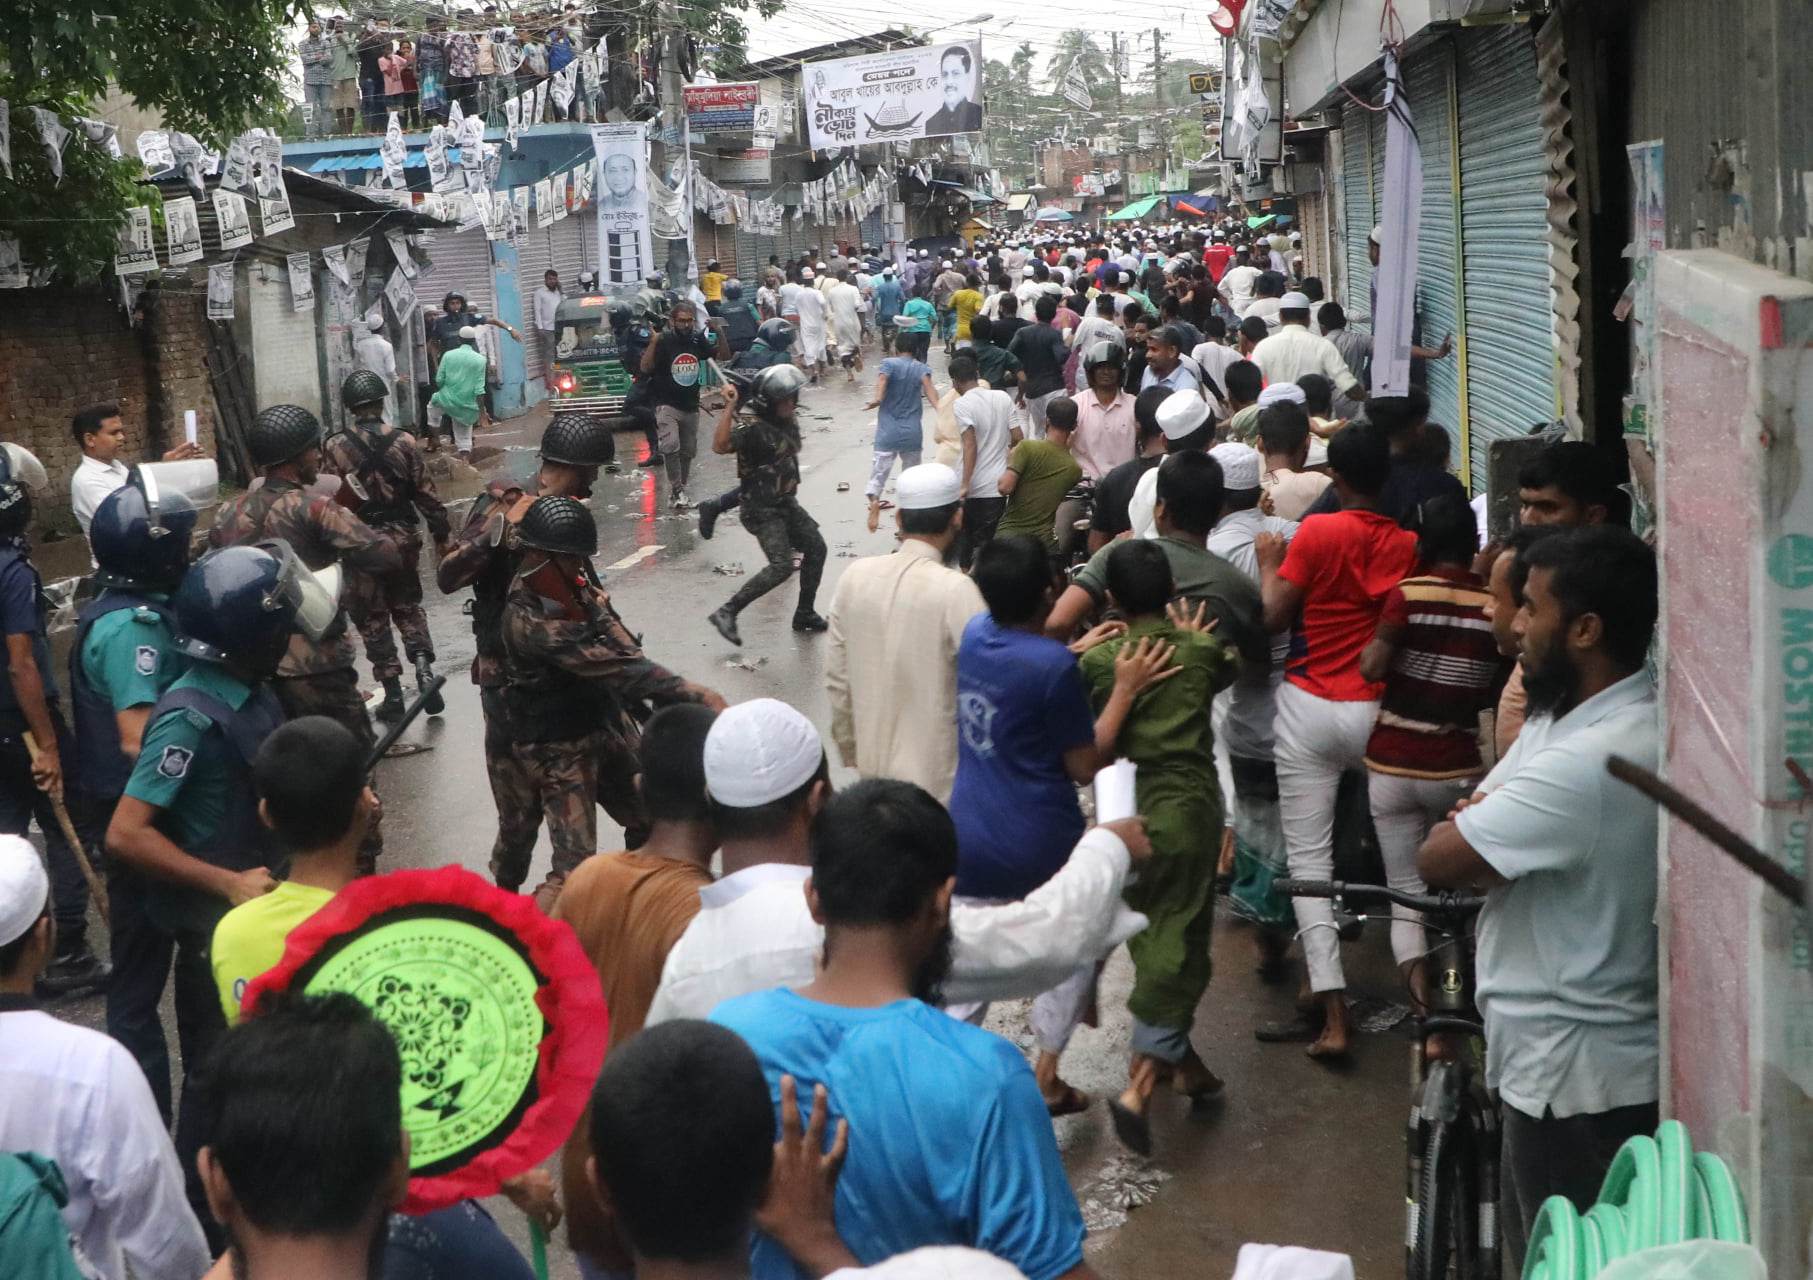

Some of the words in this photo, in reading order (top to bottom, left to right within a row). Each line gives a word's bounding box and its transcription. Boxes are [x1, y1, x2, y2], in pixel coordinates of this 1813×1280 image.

[829, 87, 853, 103] আবুল
[856, 83, 881, 98] খায়ের
[926, 76, 939, 90] কে
[814, 101, 856, 129] নৌকায়
[824, 116, 856, 135] ভোট
[835, 129, 857, 141] দিন
